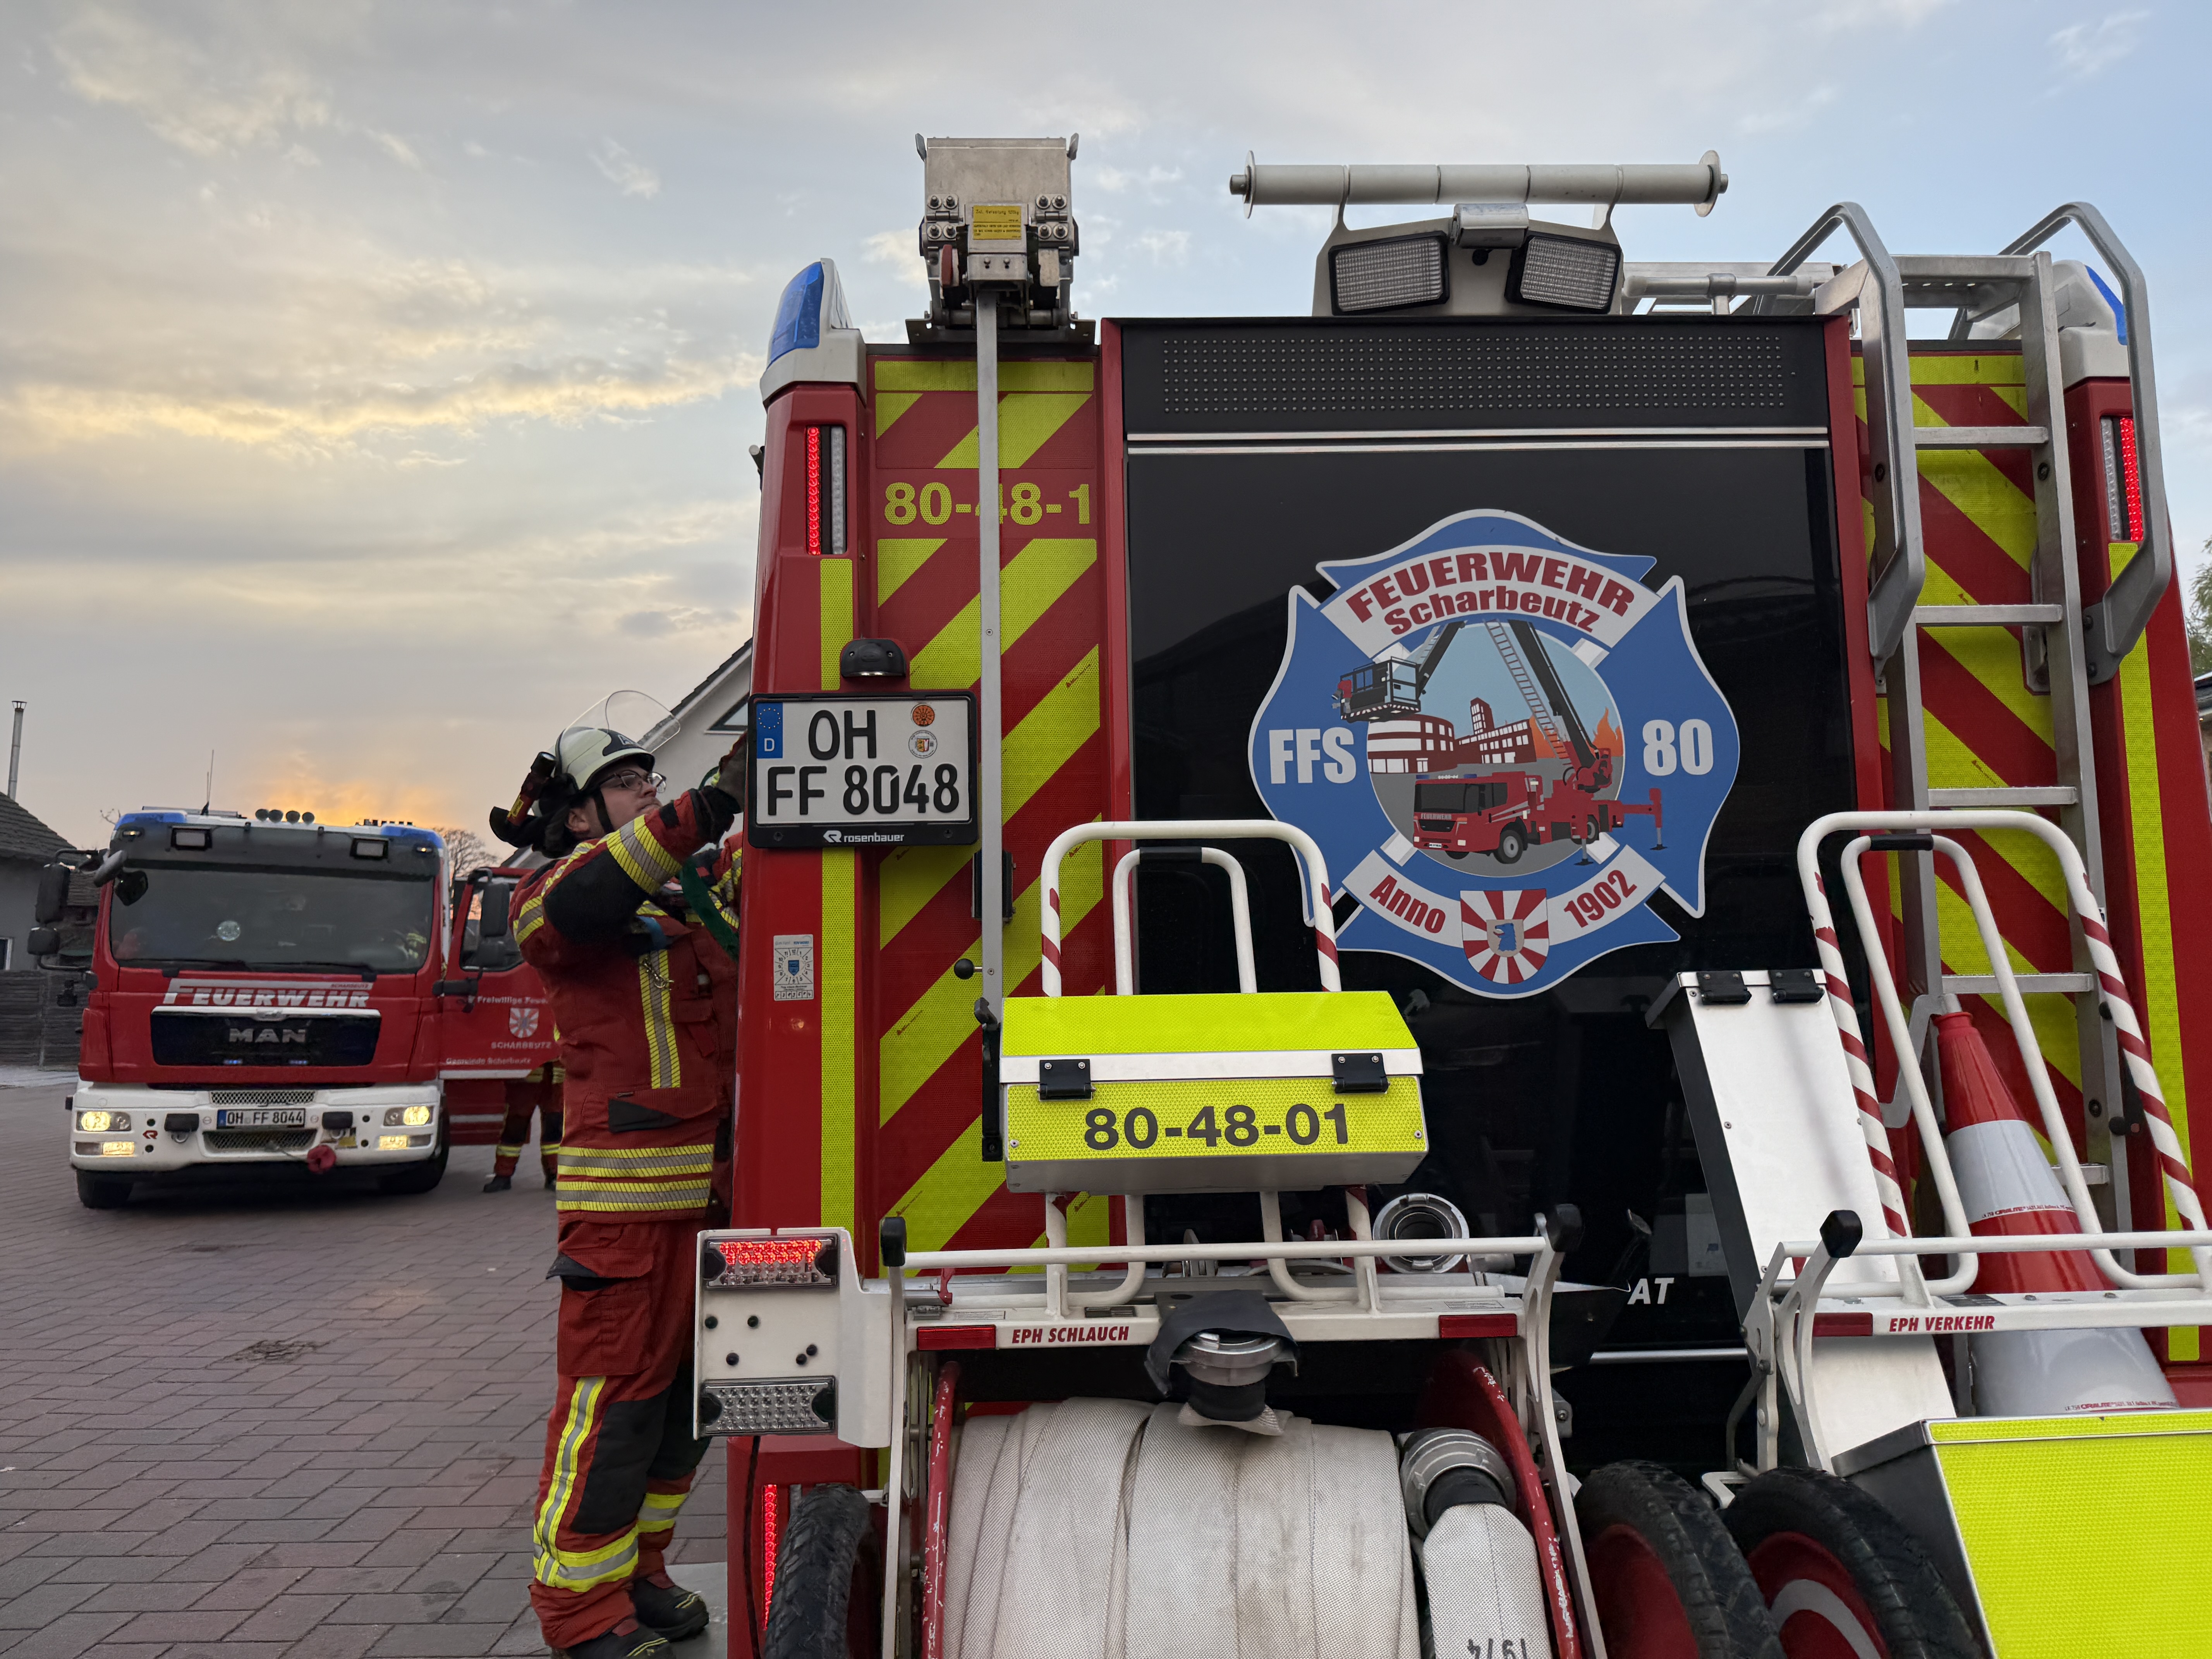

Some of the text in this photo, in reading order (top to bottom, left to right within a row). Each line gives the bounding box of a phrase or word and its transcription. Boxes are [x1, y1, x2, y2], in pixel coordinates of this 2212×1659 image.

[1346, 552, 1635, 623] FEUERWEHR
[1384, 586, 1601, 636] Scharbeutz
[764, 738, 775, 752] D
[808, 710, 877, 760] OH
[1269, 727, 1357, 785] FFS
[1642, 719, 1714, 776] 80
[768, 763, 959, 816] FF 8048
[844, 833, 905, 843] rosenbauer
[1369, 874, 1447, 934] Anno
[1563, 869, 1638, 928] 1902
[163, 978, 373, 1007] FEUERWEHR
[229, 1028, 306, 1043] MAN
[227, 1111, 302, 1124] OH FF 8044
[1084, 1103, 1349, 1151] 80-48-01
[1627, 1278, 1674, 1305] AT
[1012, 1326, 1130, 1344] EPH SCHLAUCH
[1889, 1316, 1995, 1332] EPH VERKEHR
